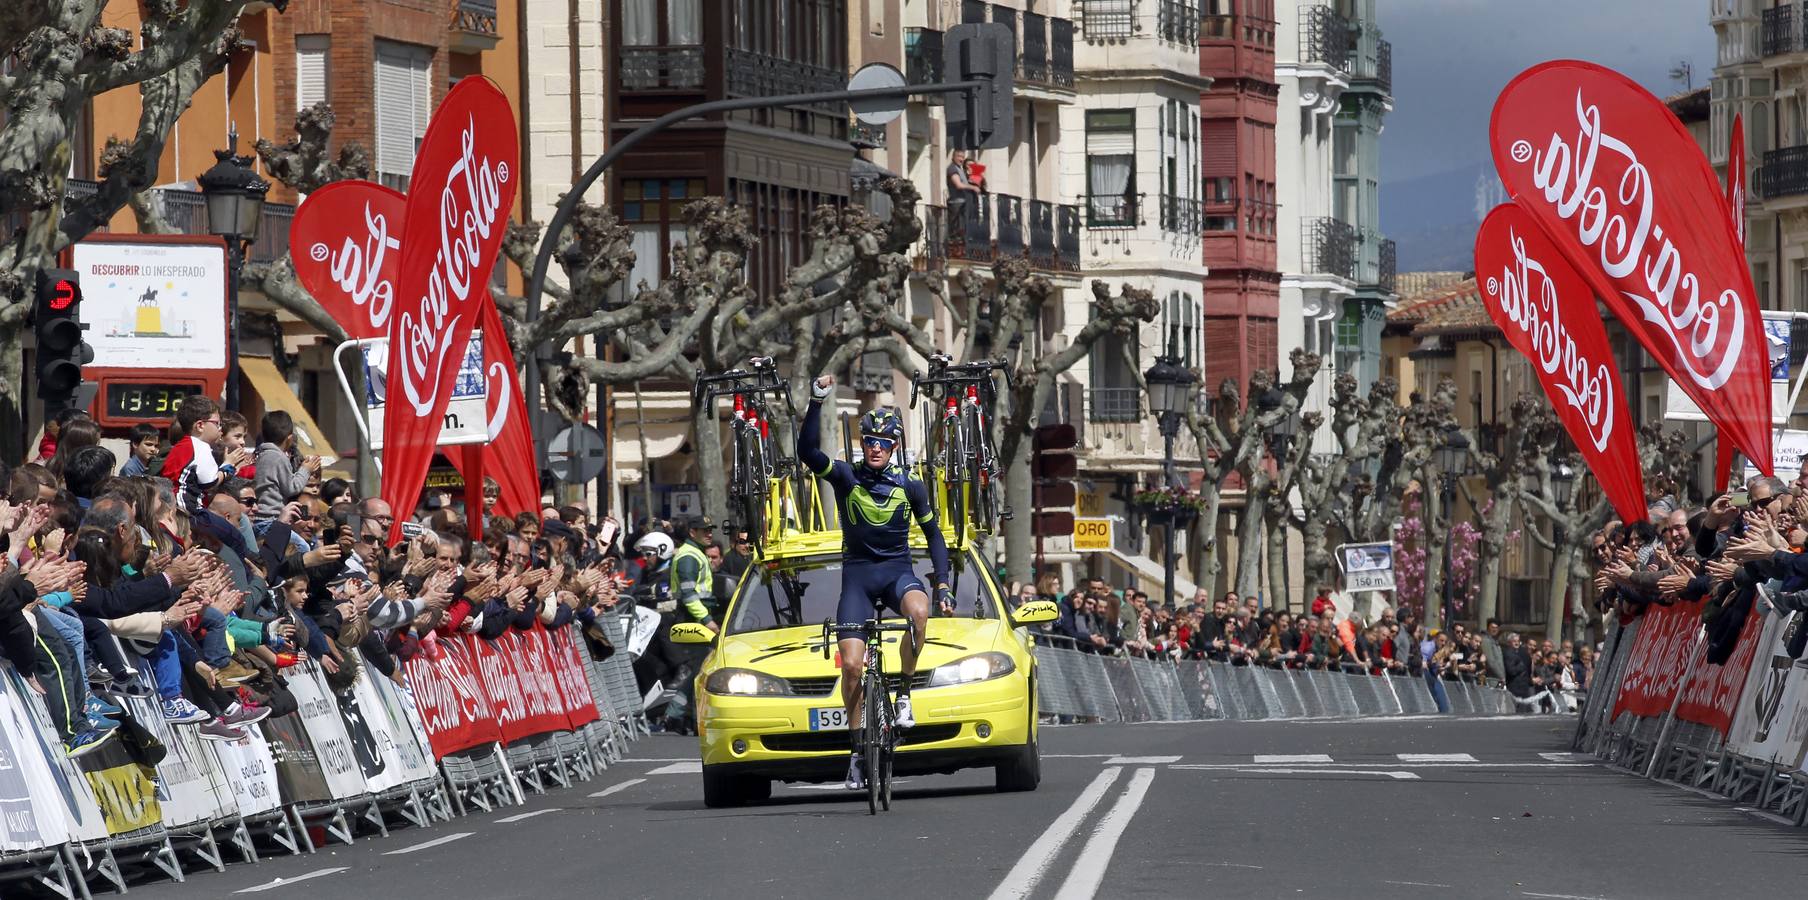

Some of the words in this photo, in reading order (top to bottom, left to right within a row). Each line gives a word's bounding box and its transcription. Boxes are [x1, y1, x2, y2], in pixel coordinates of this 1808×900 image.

[91, 264, 140, 276] DESCUBRIR
[141, 265, 152, 277] LO
[153, 266, 206, 278] INESPERADO
[400, 111, 500, 417] Coca-Cola
[1077, 522, 1107, 536] ORO
[1355, 578, 1371, 586] 150
